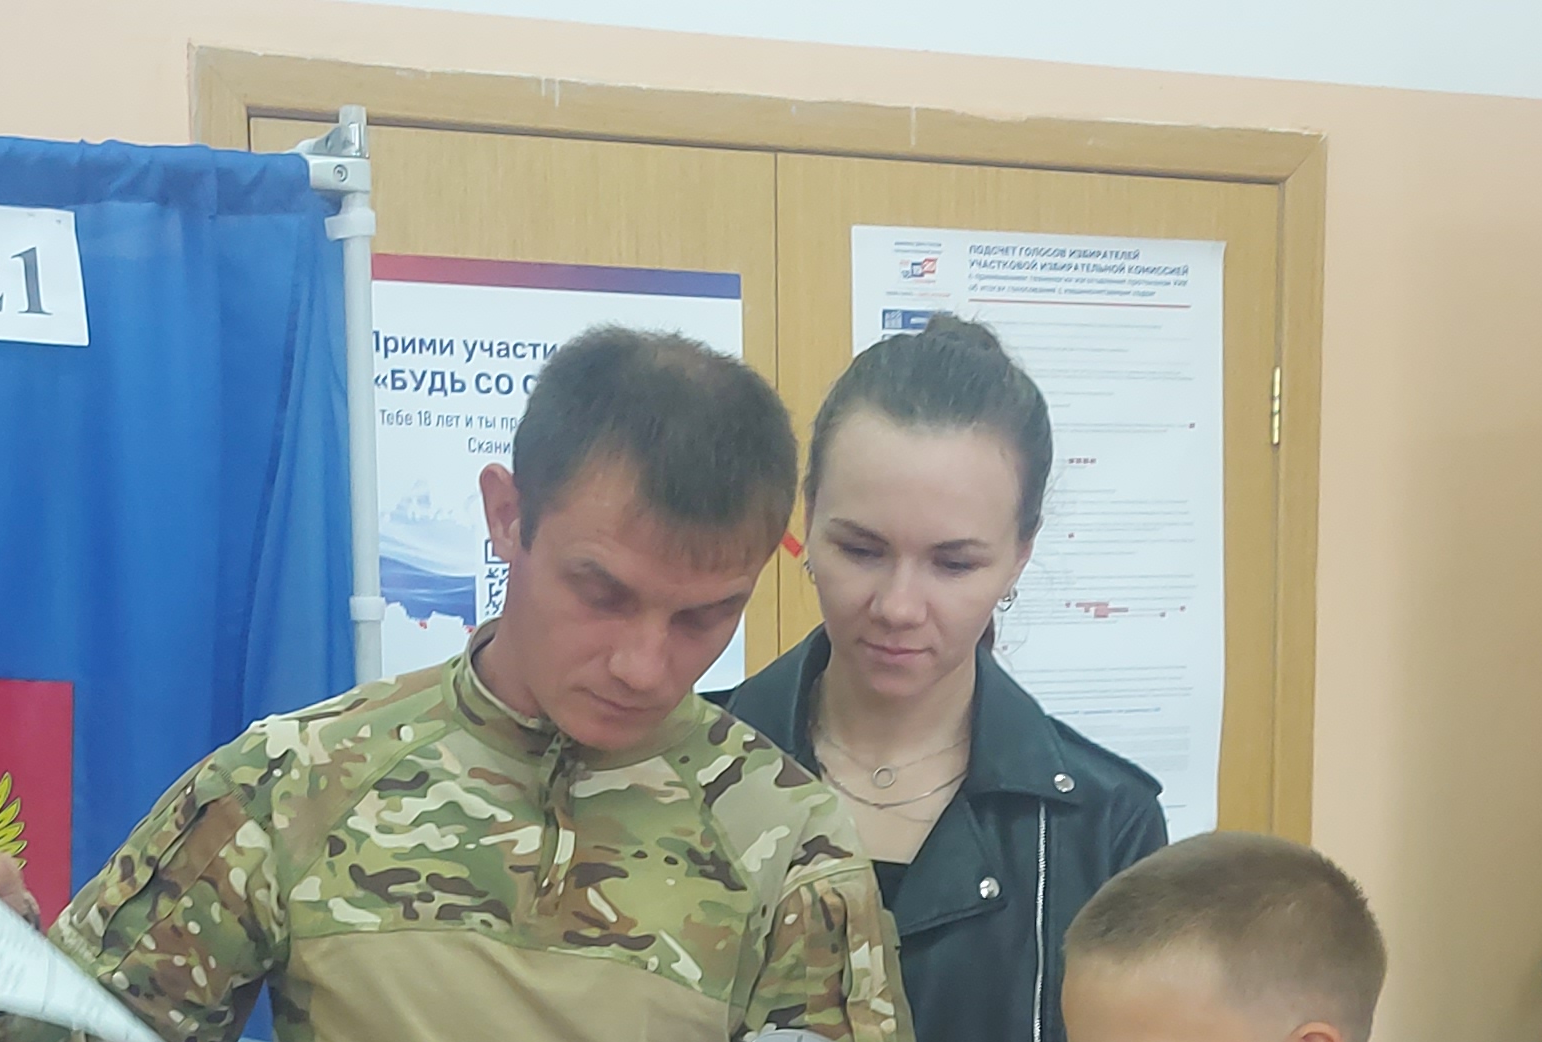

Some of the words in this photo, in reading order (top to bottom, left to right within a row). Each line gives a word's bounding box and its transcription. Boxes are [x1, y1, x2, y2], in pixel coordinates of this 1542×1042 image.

[463, 337, 557, 363] участи
[374, 368, 467, 397] «БУДЬ
[475, 371, 514, 395] СО
[379, 408, 413, 426] Тебе
[417, 410, 432, 427] 18
[435, 413, 461, 429] лет
[465, 414, 474, 428] и
[477, 415, 496, 430] ты
[467, 436, 510, 454] Скани
